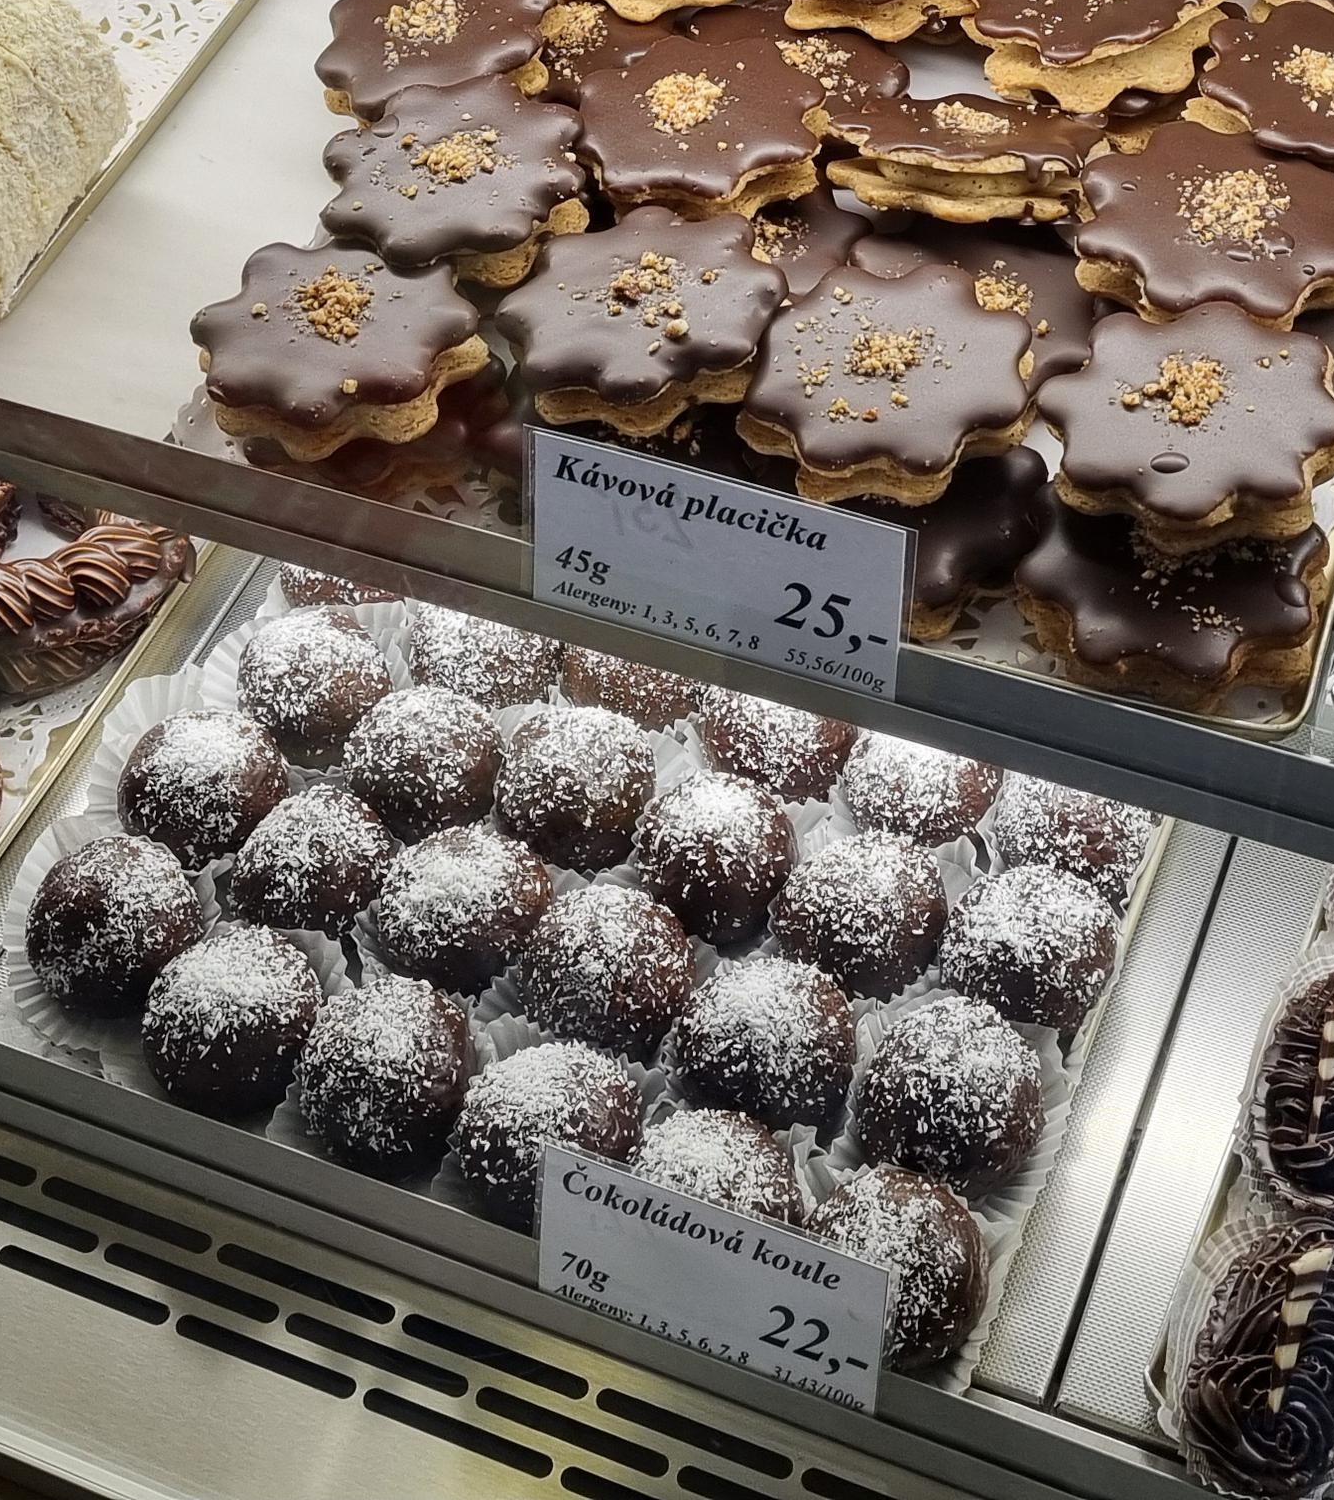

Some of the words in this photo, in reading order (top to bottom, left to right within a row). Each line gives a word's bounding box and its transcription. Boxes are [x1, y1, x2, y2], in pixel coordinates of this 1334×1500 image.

[552, 453, 675, 509] Kávová
[679, 494, 828, 552] placička
[555, 545, 612, 586] 45g
[552, 579, 638, 616] Alergeny:
[642, 603, 657, 625] 1,
[661, 609, 678, 631] 3,
[683, 615, 699, 637] 5,
[705, 622, 721, 643] 6,
[728, 628, 743, 649] 7,
[748, 634, 761, 651] 8
[774, 581, 889, 655] 25,-
[783, 647, 887, 694] 55,56/100g
[563, 1163, 743, 1255] Čokoládová
[751, 1238, 842, 1291] koule
[561, 1250, 612, 1294] 70g
[554, 1283, 634, 1323] Alergeny:
[639, 1313, 652, 1331] 1,
[658, 1320, 672, 1338] 3,
[677, 1328, 692, 1347] 5,
[697, 1335, 713, 1354] 6,
[719, 1342, 734, 1362] 7,
[737, 1349, 750, 1366] 8
[758, 1303, 870, 1376] 22,-
